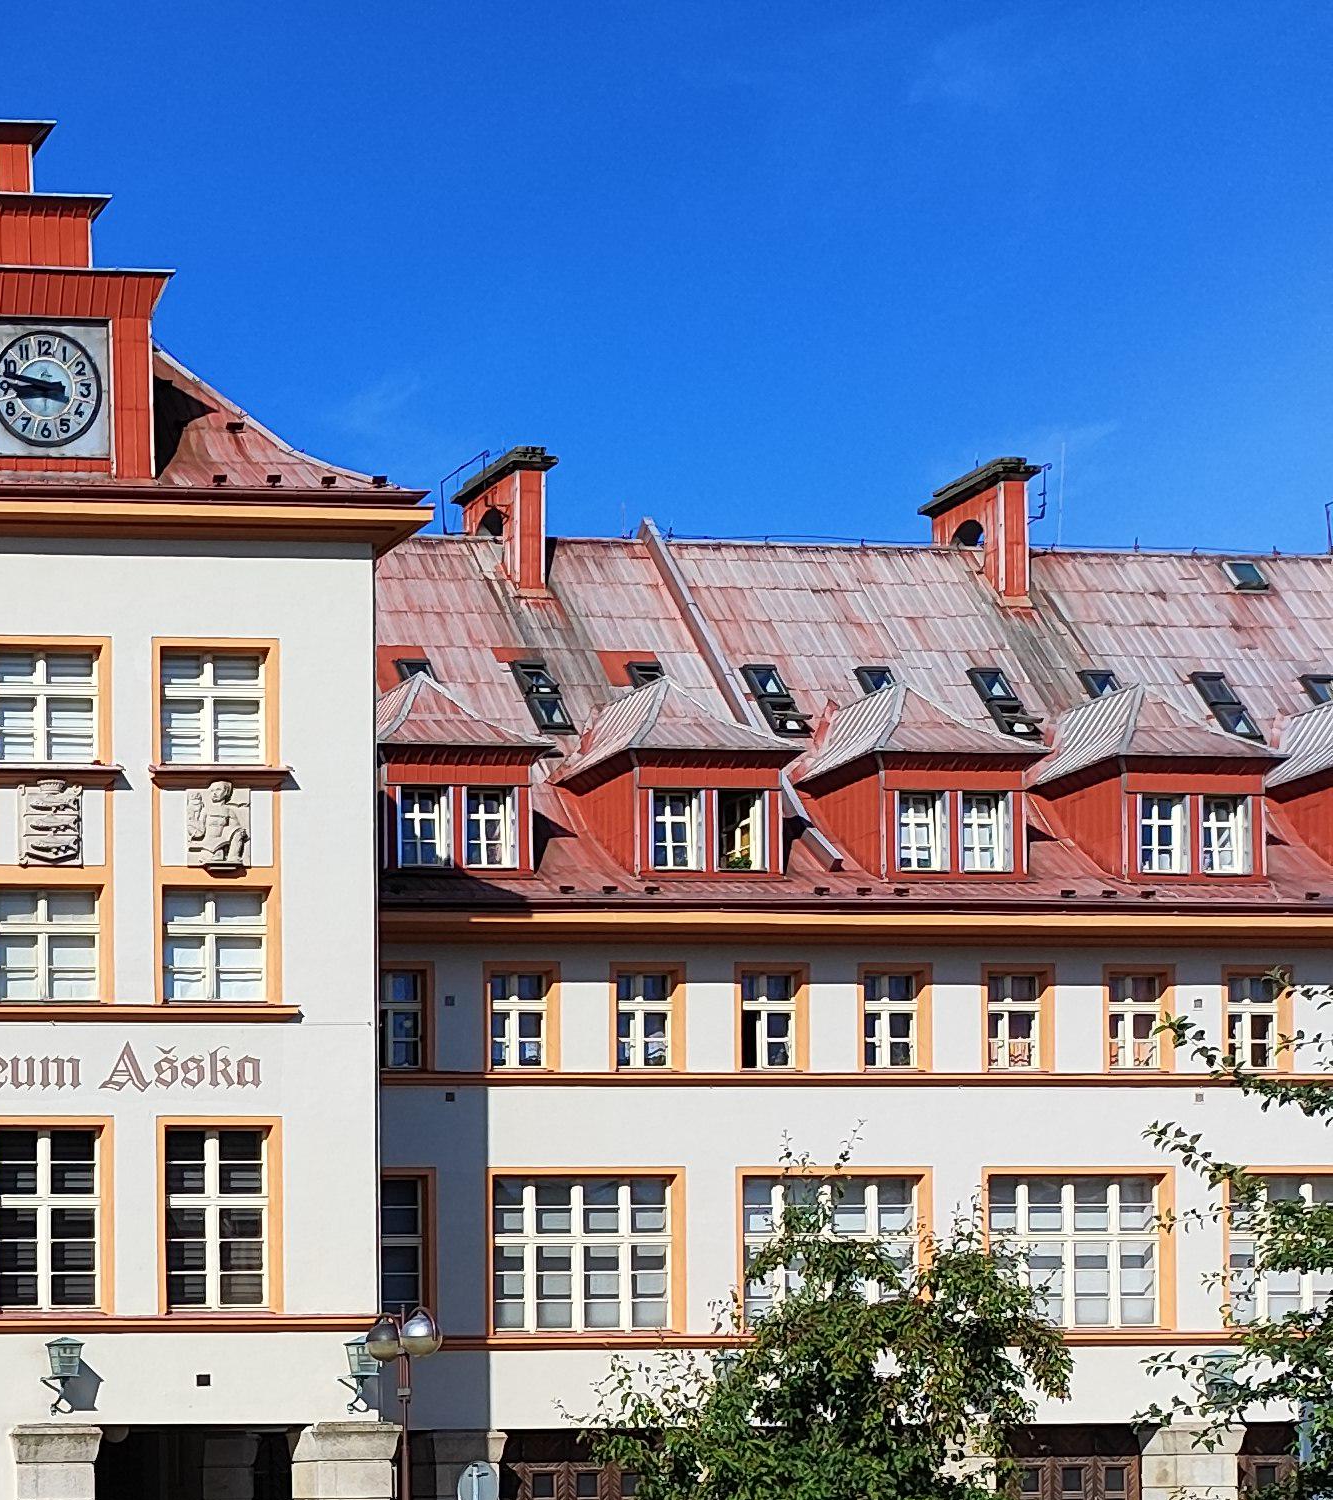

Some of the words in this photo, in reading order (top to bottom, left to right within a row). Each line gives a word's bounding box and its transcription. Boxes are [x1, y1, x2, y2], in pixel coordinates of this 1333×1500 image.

[19, 343, 30, 360] 11
[37, 339, 52, 356] 12
[62, 346, 67, 362] 1
[3, 358, 17, 375] 10
[74, 360, 86, 376] 2
[0, 380, 11, 396] 9
[79, 382, 92, 398] 3
[5, 401, 16, 416] 8
[74, 402, 85, 418] 4
[21, 416, 32, 432] 7
[40, 422, 52, 438] 6
[59, 418, 71, 433] 5
[98, 1041, 263, 1094] Ašska
